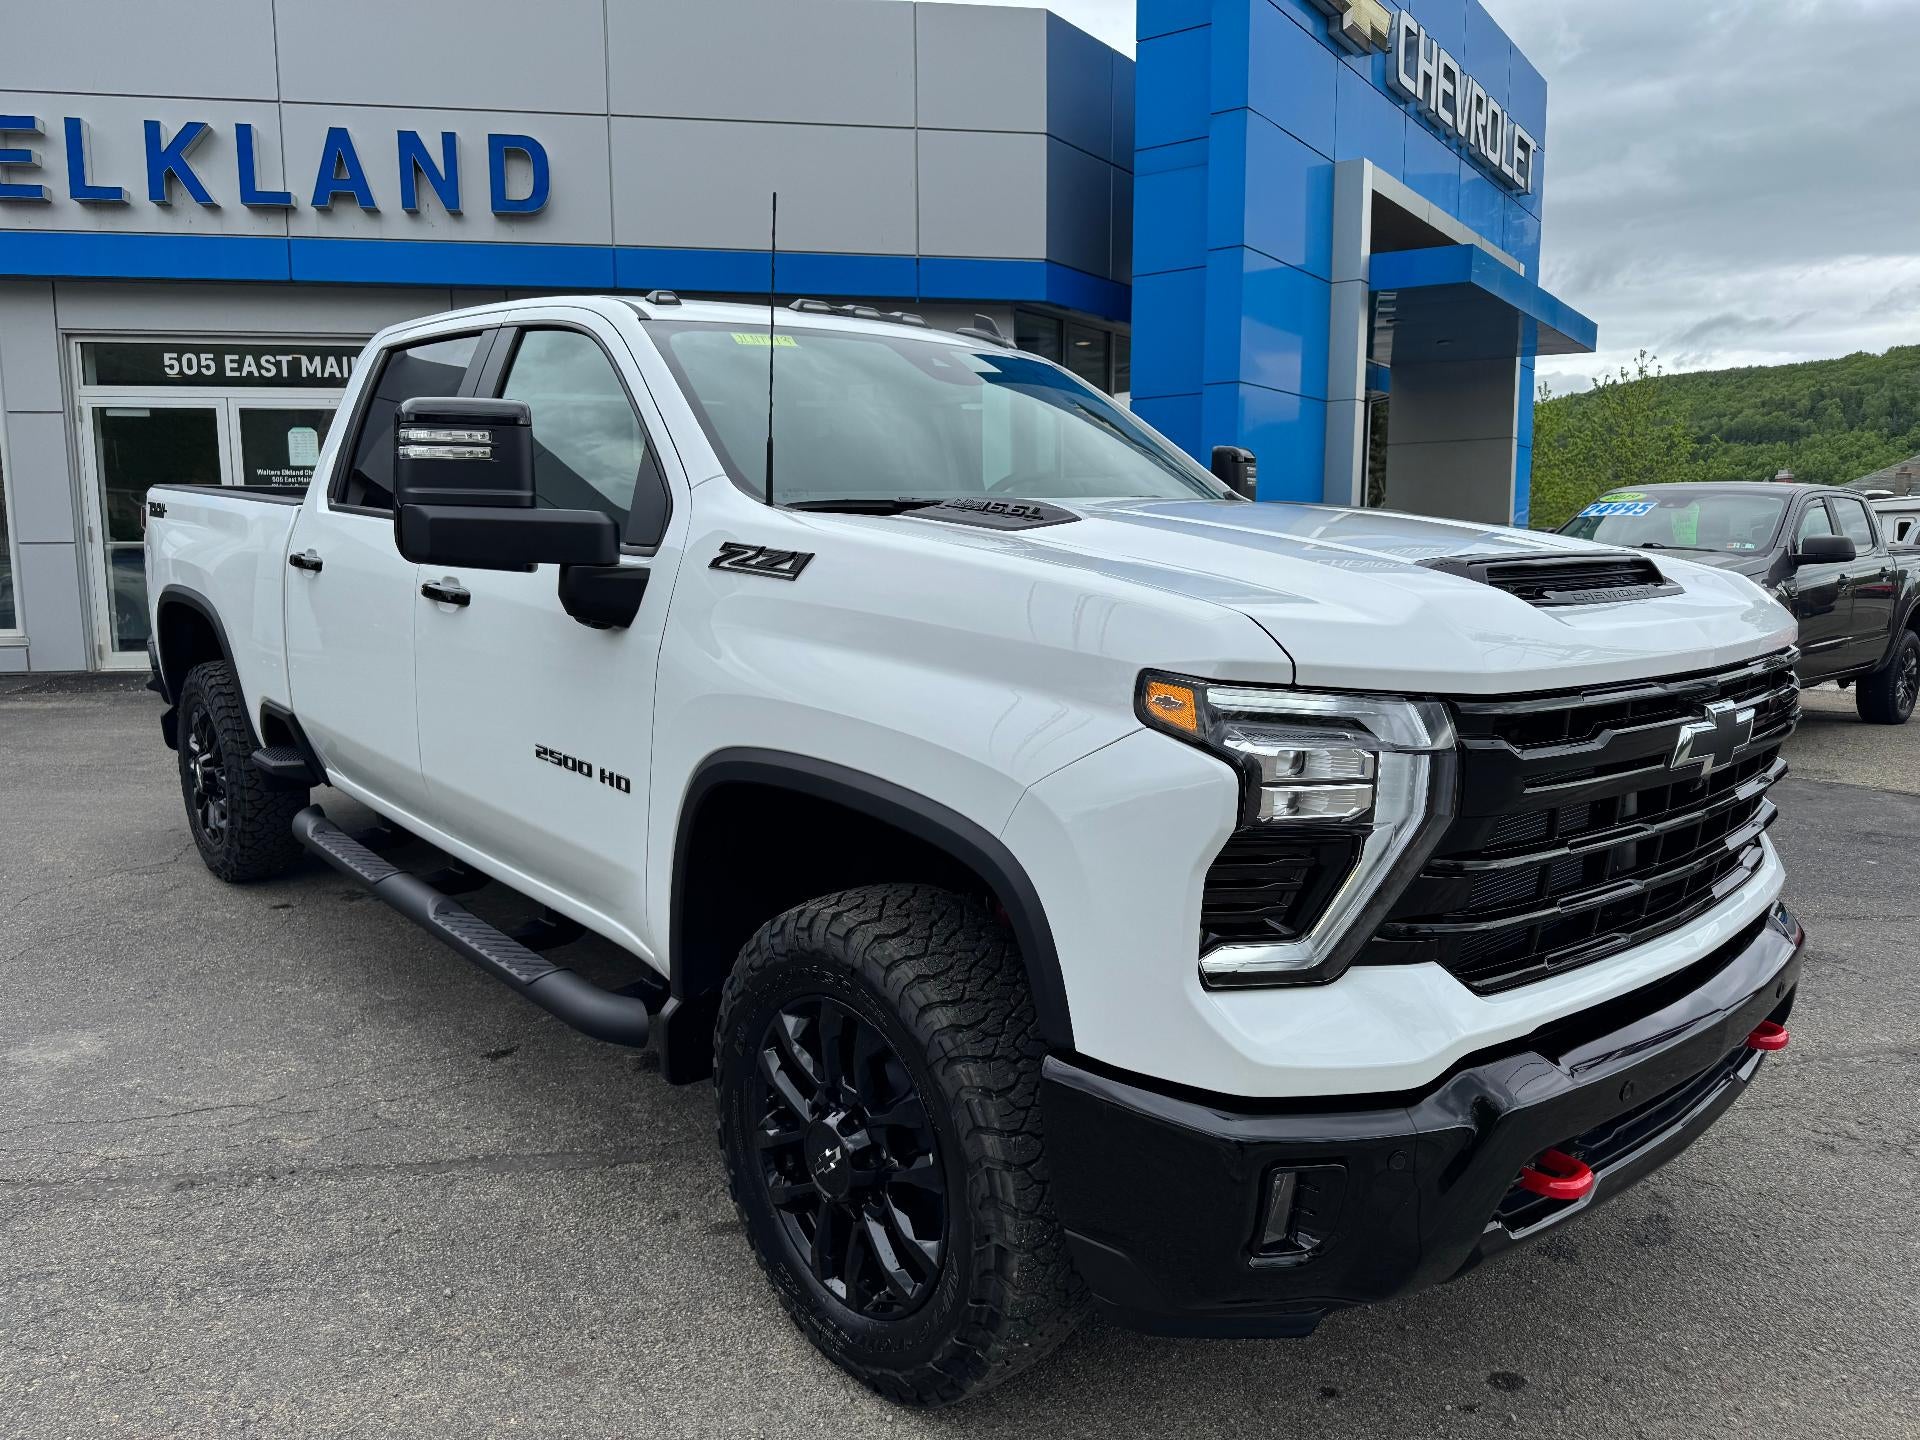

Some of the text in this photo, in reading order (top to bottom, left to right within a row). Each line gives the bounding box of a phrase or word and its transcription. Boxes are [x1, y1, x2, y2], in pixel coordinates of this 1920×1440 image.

[1398, 9, 1538, 195] CHEVROLET
[0, 114, 551, 216] ELKLAND
[163, 352, 216, 376] 505
[224, 354, 293, 378] EAST
[1581, 502, 1653, 515] 24995
[707, 541, 816, 581] Z71
[1570, 587, 1651, 601] CHEVROLET
[535, 743, 631, 794] 2500 HD
